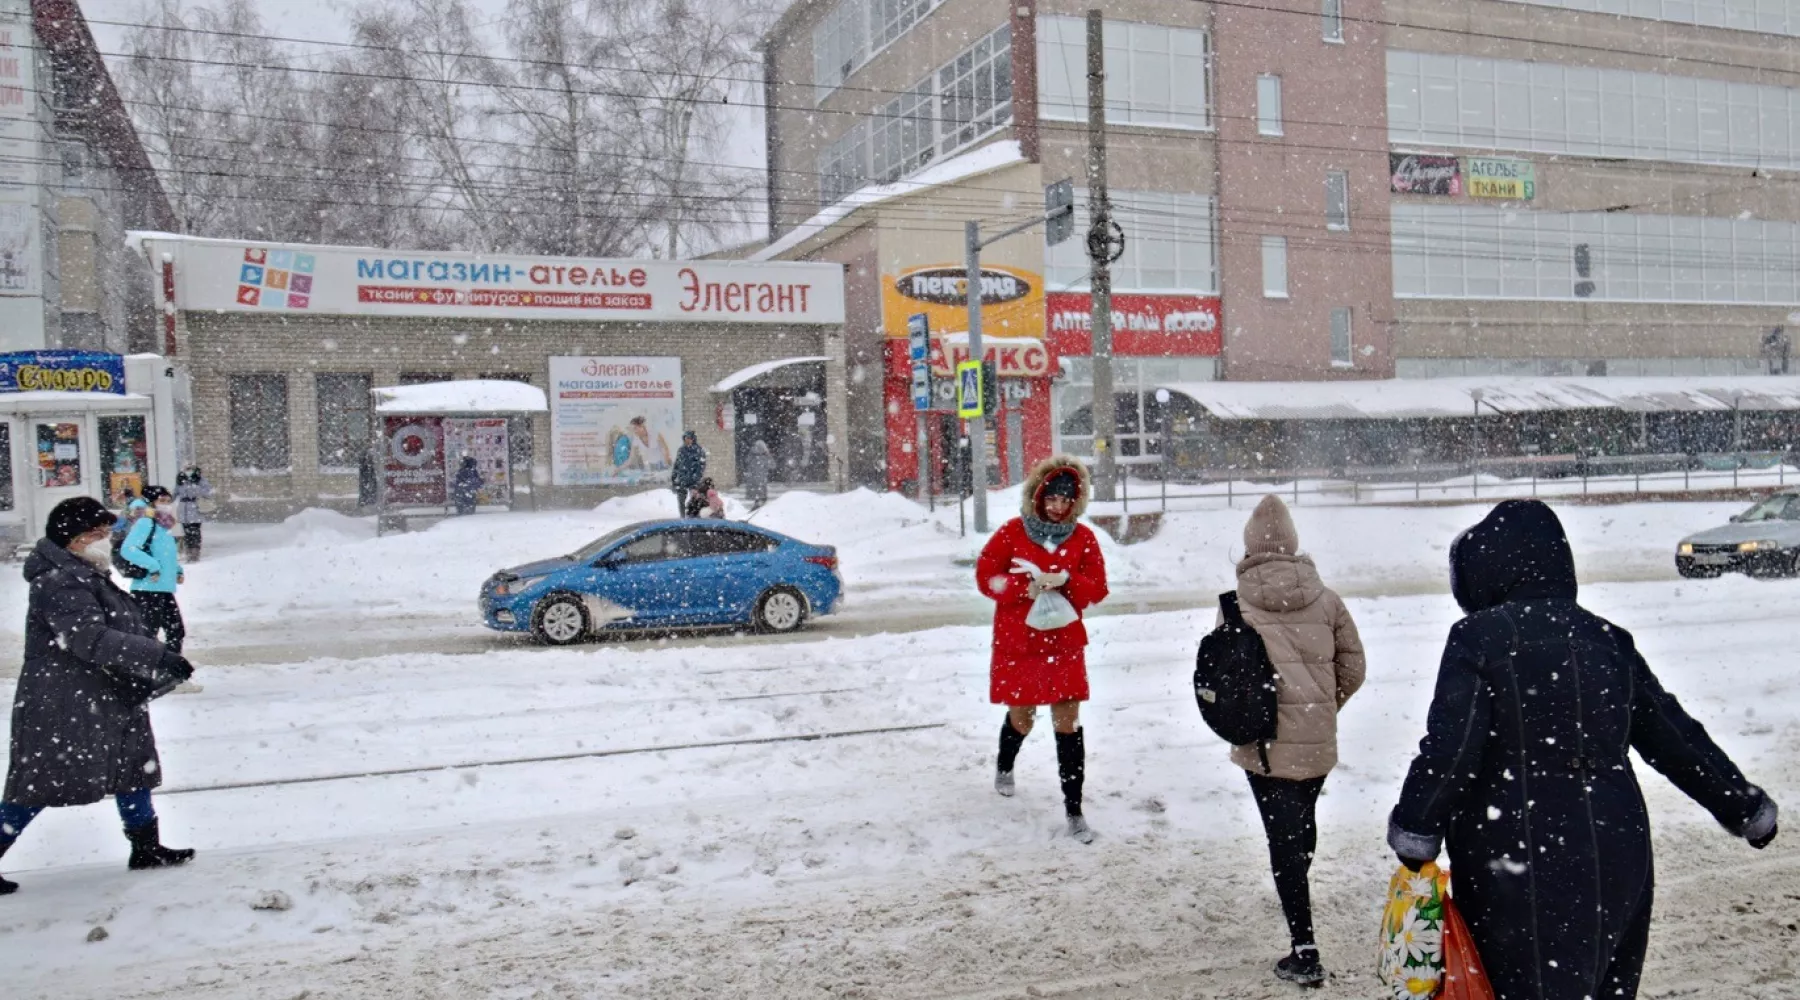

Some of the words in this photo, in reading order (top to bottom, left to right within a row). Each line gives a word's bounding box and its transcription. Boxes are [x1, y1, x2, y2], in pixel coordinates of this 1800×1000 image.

[1473, 180, 1517, 196] ТКАНИ
[357, 258, 647, 288] магазин-ателье
[678, 268, 811, 313] Элегант
[912, 275, 1017, 296] пекня
[367, 289, 414, 300] ткани
[432, 290, 518, 305] фунитура
[534, 294, 581, 305] пошив
[584, 296, 602, 305] на
[605, 296, 645, 307] заказ
[1053, 310, 1127, 331] АПТЕА
[581, 359, 649, 376] «Элегант»
[558, 380, 673, 390] магазин-ателье
